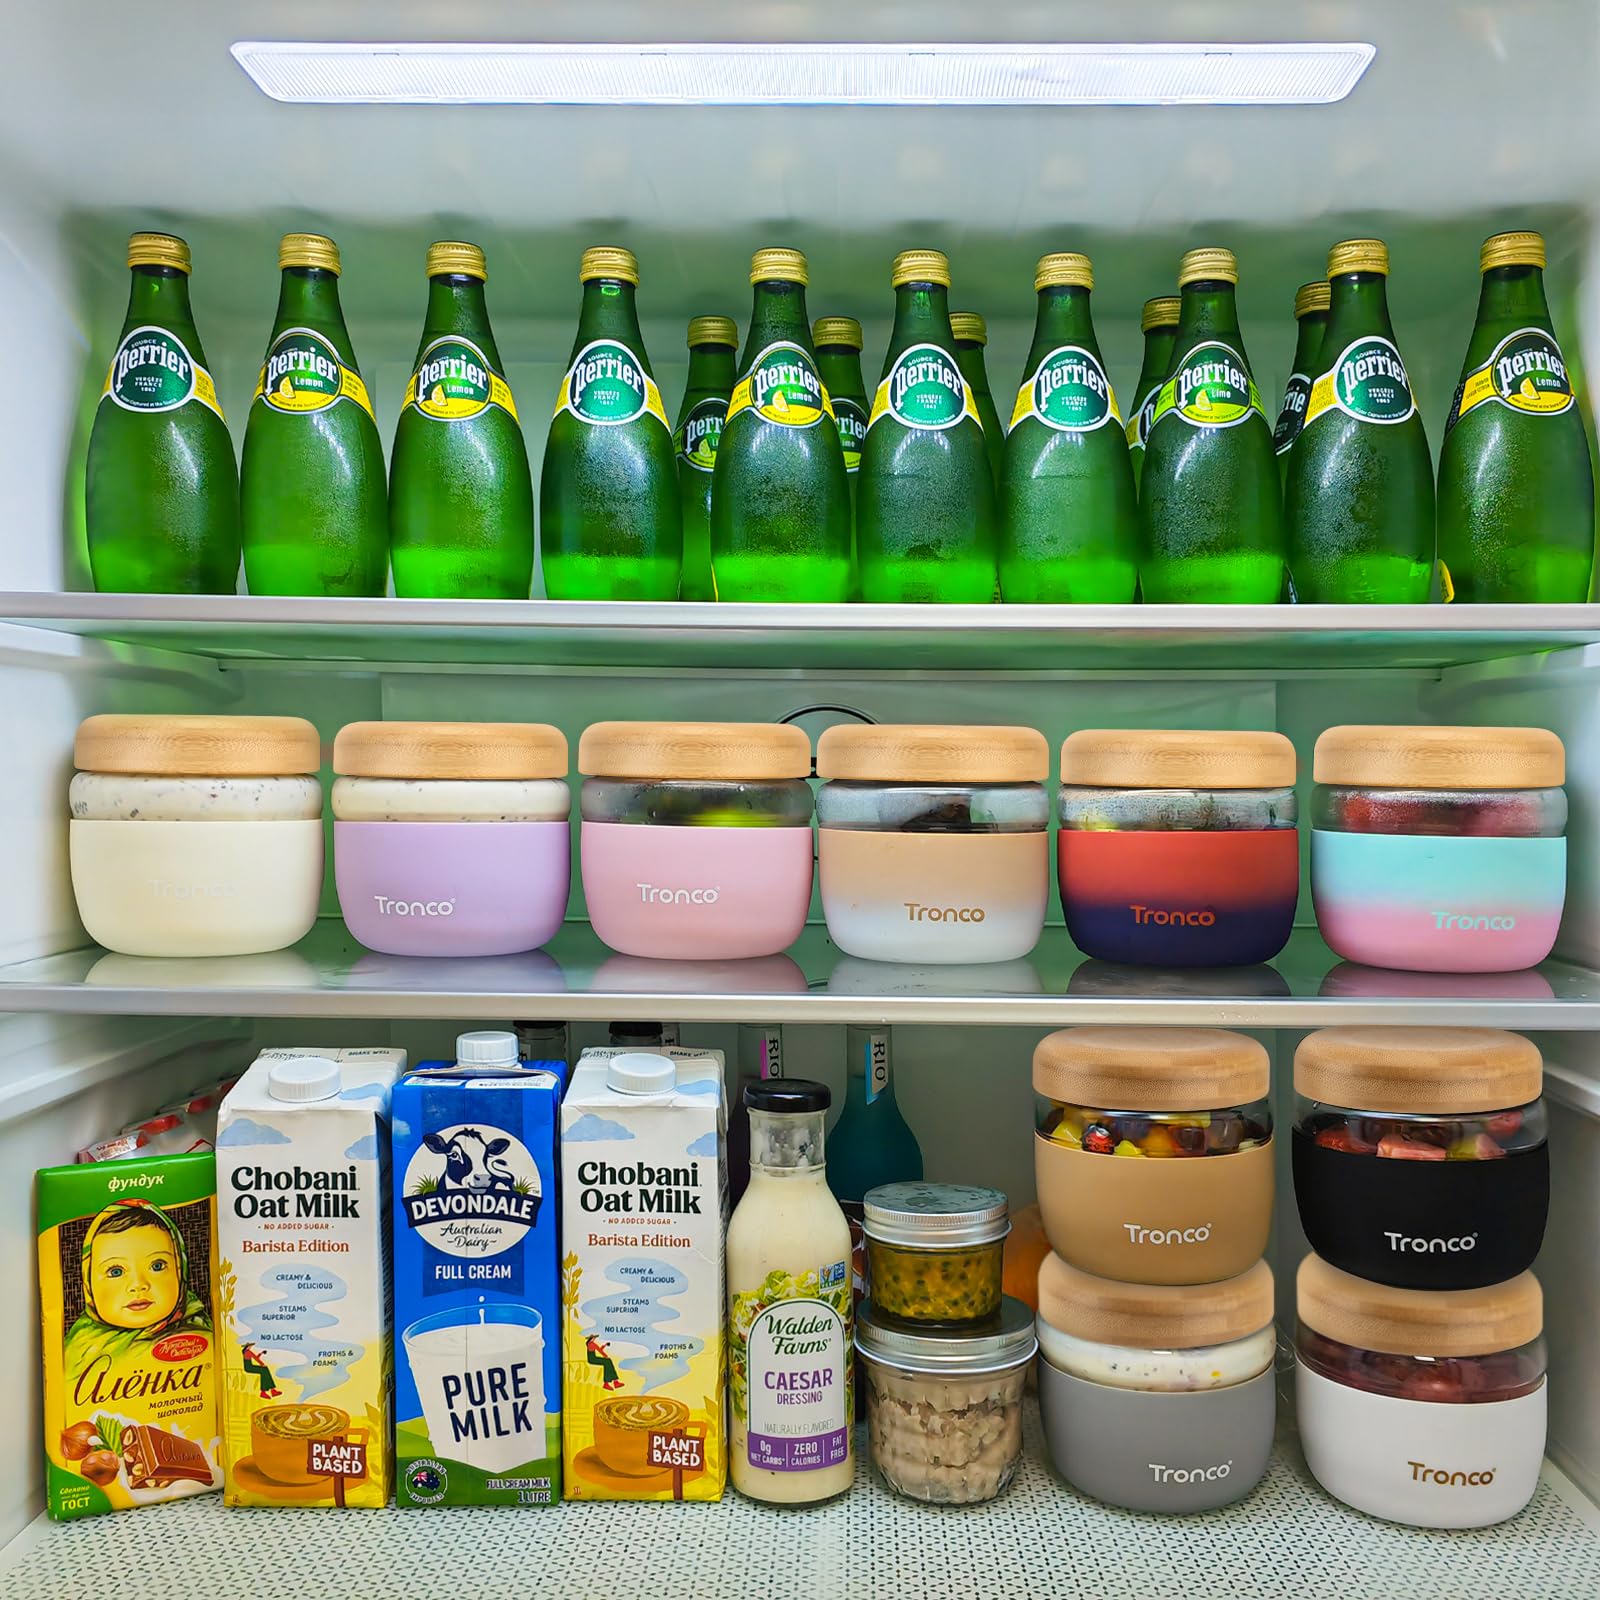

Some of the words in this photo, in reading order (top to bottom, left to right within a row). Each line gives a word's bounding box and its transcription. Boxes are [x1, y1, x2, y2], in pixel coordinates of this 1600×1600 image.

[115, 341, 188, 393] perrier
[265, 346, 337, 397] perrier
[1496, 347, 1568, 398] perrier
[294, 376, 323, 388] Lemon
[416, 354, 487, 405] perrier
[573, 355, 642, 407] perrier
[754, 361, 821, 410] perrier
[895, 359, 961, 411] perrier
[1039, 361, 1106, 413] perrier
[1178, 359, 1247, 410] perrier
[1341, 352, 1408, 406] perrier
[1536, 377, 1561, 387] Lemon
[447, 384, 474, 395] Lemon
[788, 391, 813, 402] Lemon
[1212, 388, 1231, 398] Lime
[636, 883, 718, 904] Tronco
[374, 895, 455, 916] Tronco
[904, 903, 986, 923] Tronco
[1130, 905, 1216, 927] Tronco
[1431, 911, 1515, 931] Tronco
[768, 1037, 780, 1077] RIO
[873, 1041, 886, 1081] RIO
[107, 1174, 165, 1193] фундук
[231, 1165, 357, 1191] Chobani
[578, 1162, 699, 1187] Chobani
[234, 1194, 289, 1218] Oat
[296, 1192, 360, 1218] Milk
[411, 1195, 534, 1221] DEVONDALE
[580, 1188, 633, 1213] Oat
[639, 1188, 701, 1214] Milk
[440, 1222, 502, 1237] Australian
[1123, 1223, 1211, 1245] Tronco
[242, 1240, 295, 1253] Barista
[298, 1239, 349, 1253] Edition
[454, 1236, 489, 1251] Dairy
[588, 1234, 638, 1247] Barista
[641, 1234, 691, 1248] Edition
[1383, 1231, 1477, 1253] Tronco
[435, 1265, 465, 1280] FULL
[468, 1264, 512, 1279] CREAM
[297, 1282, 333, 1290] DELICIOUS
[765, 1315, 833, 1335] Walden
[772, 1336, 828, 1355] Farms
[74, 1354, 204, 1407] Алёнка
[442, 1362, 529, 1410] PURE
[764, 1368, 833, 1391] CAESAR
[148, 1392, 203, 1410] молочный
[777, 1391, 823, 1405] DRESSING
[157, 1402, 203, 1419] шоколад
[450, 1399, 533, 1443] MILK
[764, 1422, 801, 1434] NATURALLY
[803, 1419, 834, 1433] FLAVORED
[653, 1436, 700, 1453] PLANT
[760, 1440, 772, 1456] 0g
[794, 1442, 818, 1456] ZERO
[832, 1435, 842, 1447] FAT
[313, 1443, 361, 1460] PLANT
[653, 1450, 701, 1467] BASED
[751, 1452, 761, 1460] NET
[791, 1455, 821, 1466] CALORIES
[830, 1446, 844, 1460] FREE
[312, 1457, 362, 1474] BASED
[1149, 1460, 1232, 1484] Tronco
[1408, 1461, 1496, 1487] Tronco
[486, 1479, 504, 1489] FULL
[505, 1478, 531, 1489] CREAM
[532, 1477, 551, 1488] MILK
[62, 1496, 90, 1511] ГОСТ
[518, 1490, 525, 1503] 1
[526, 1491, 551, 1503] LITRE
